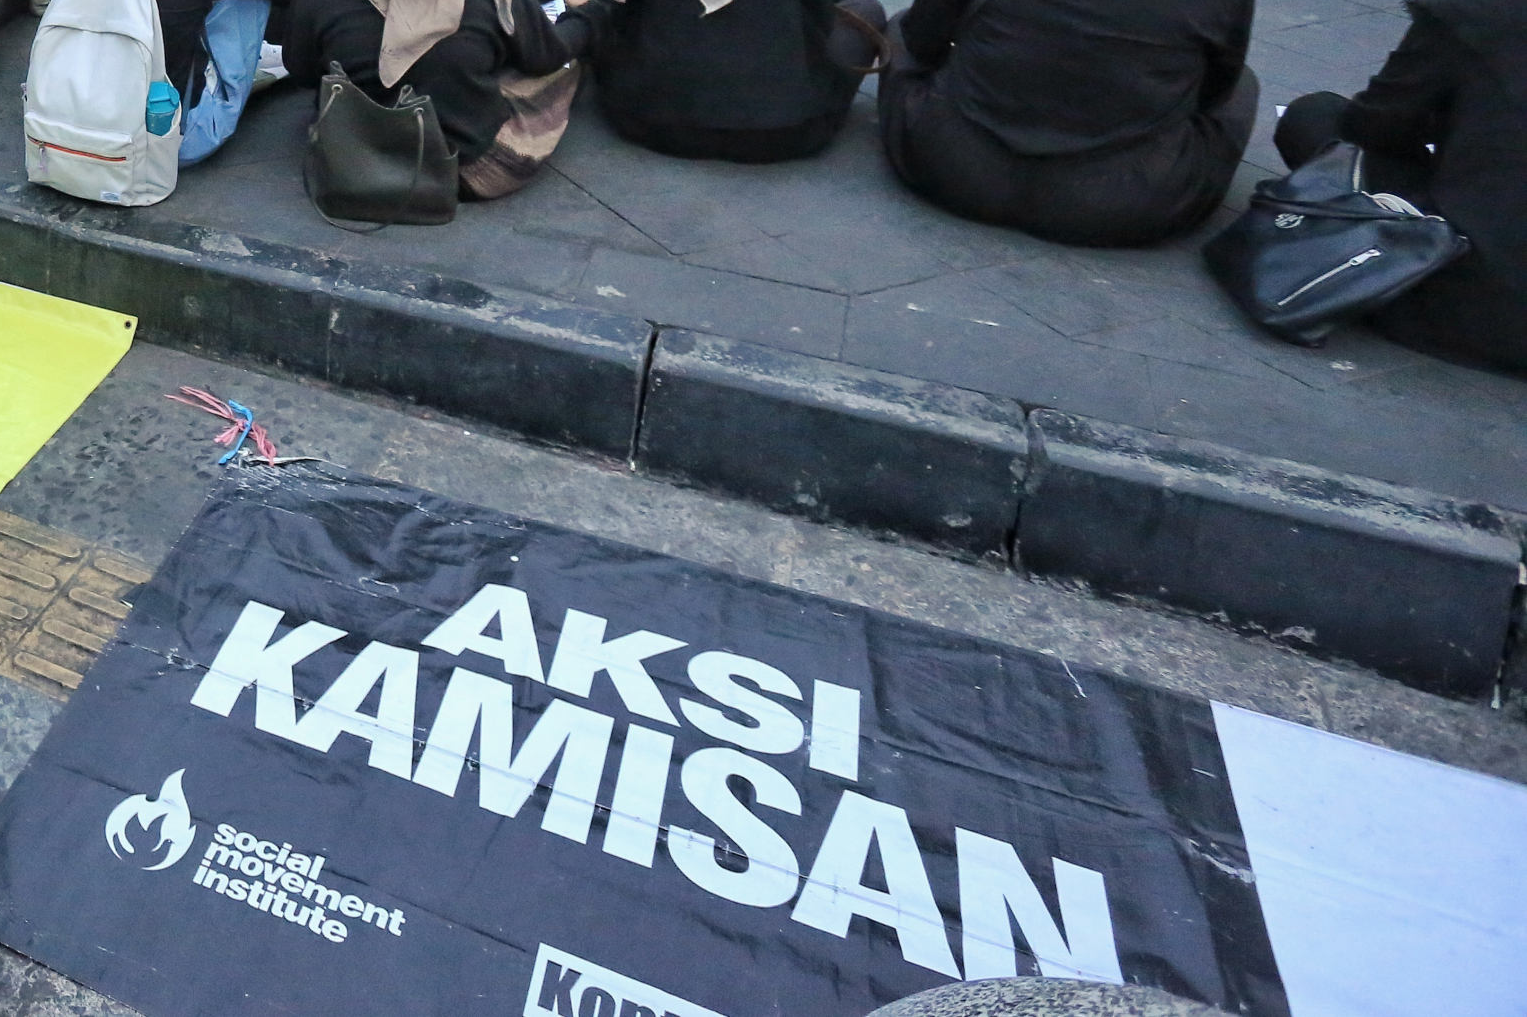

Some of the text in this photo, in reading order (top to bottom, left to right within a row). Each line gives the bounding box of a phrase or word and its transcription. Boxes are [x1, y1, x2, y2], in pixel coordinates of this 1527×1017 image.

[421, 584, 860, 781] AKSI
[190, 600, 1122, 984] KAMISAN
[203, 841, 406, 937] movement
[213, 823, 326, 881] social
[192, 859, 348, 943] institute
